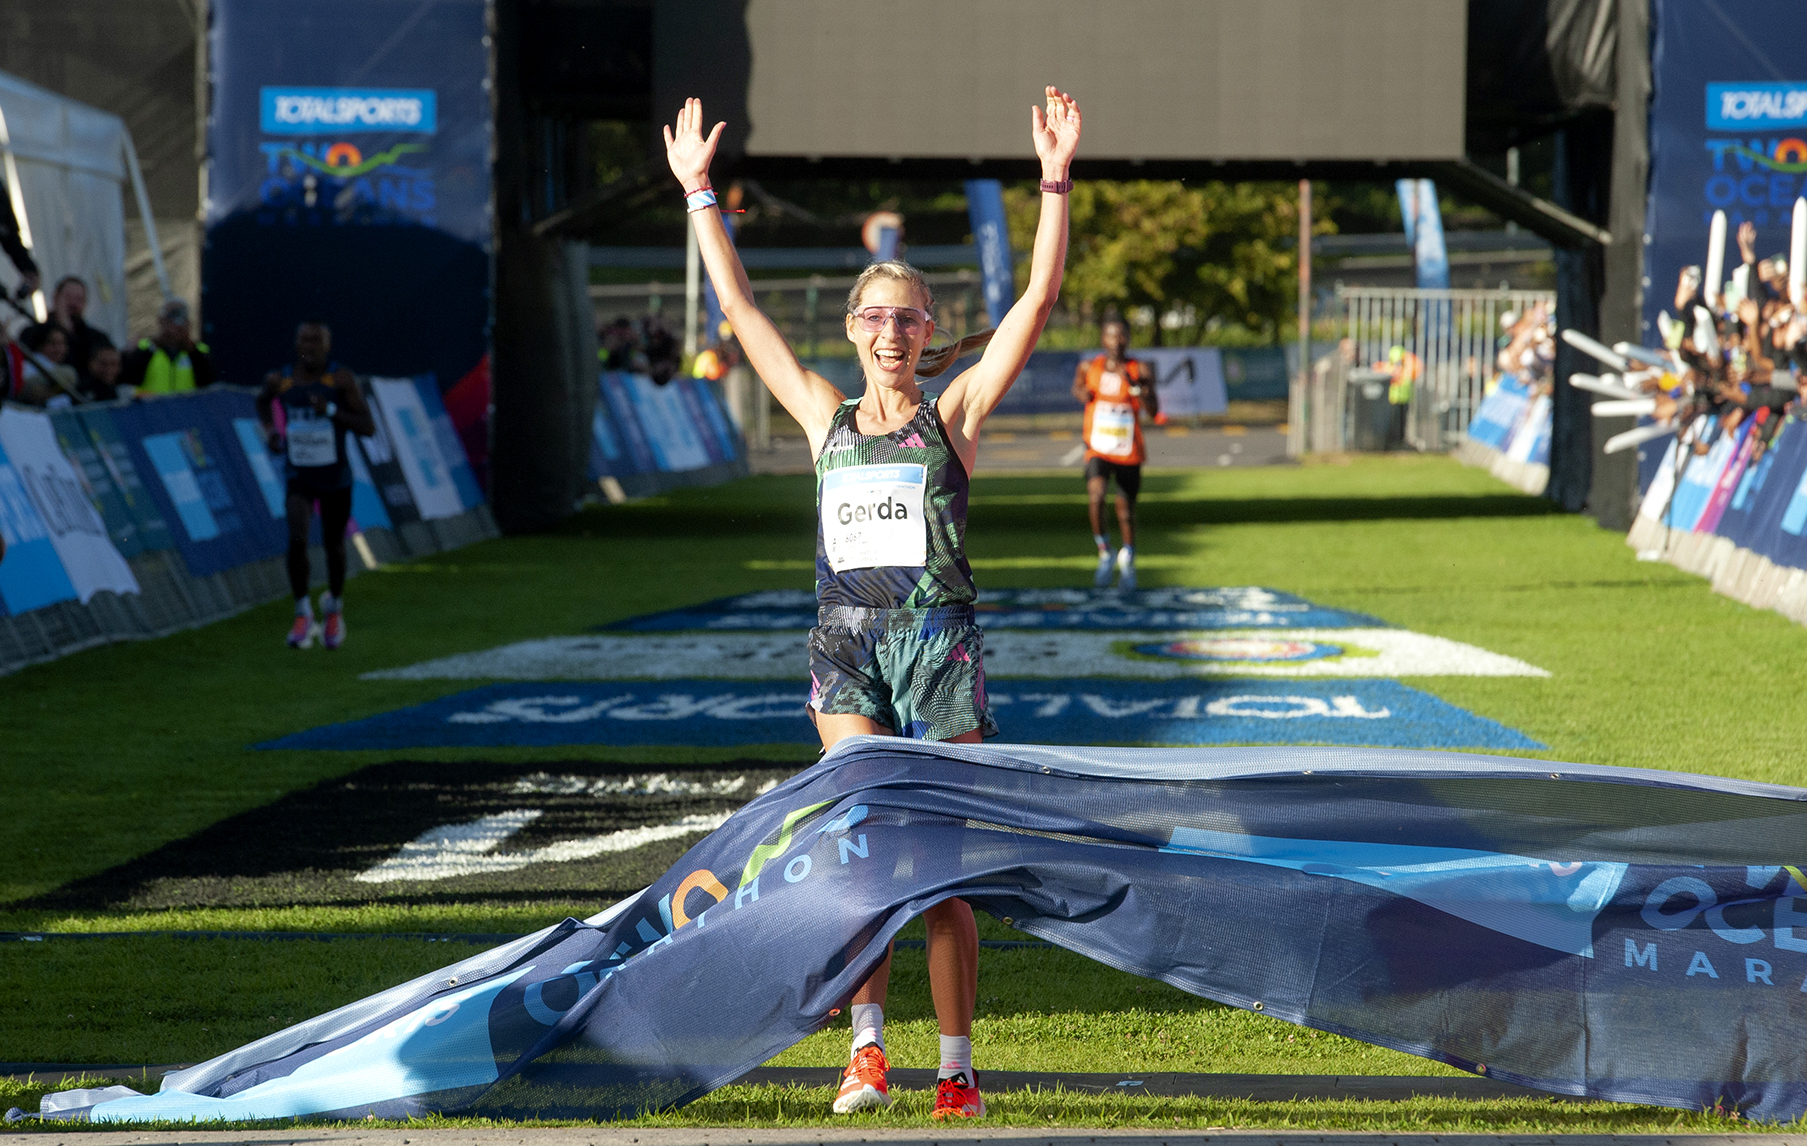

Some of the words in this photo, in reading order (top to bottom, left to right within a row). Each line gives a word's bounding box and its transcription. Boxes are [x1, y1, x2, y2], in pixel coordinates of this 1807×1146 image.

[275, 95, 422, 124] TOTALSPORTS
[1704, 174, 1807, 207] OCE
[837, 496, 908, 525] Gerda
[447, 692, 1391, 724] TOTALORTS
[1625, 938, 1807, 992] MAR
